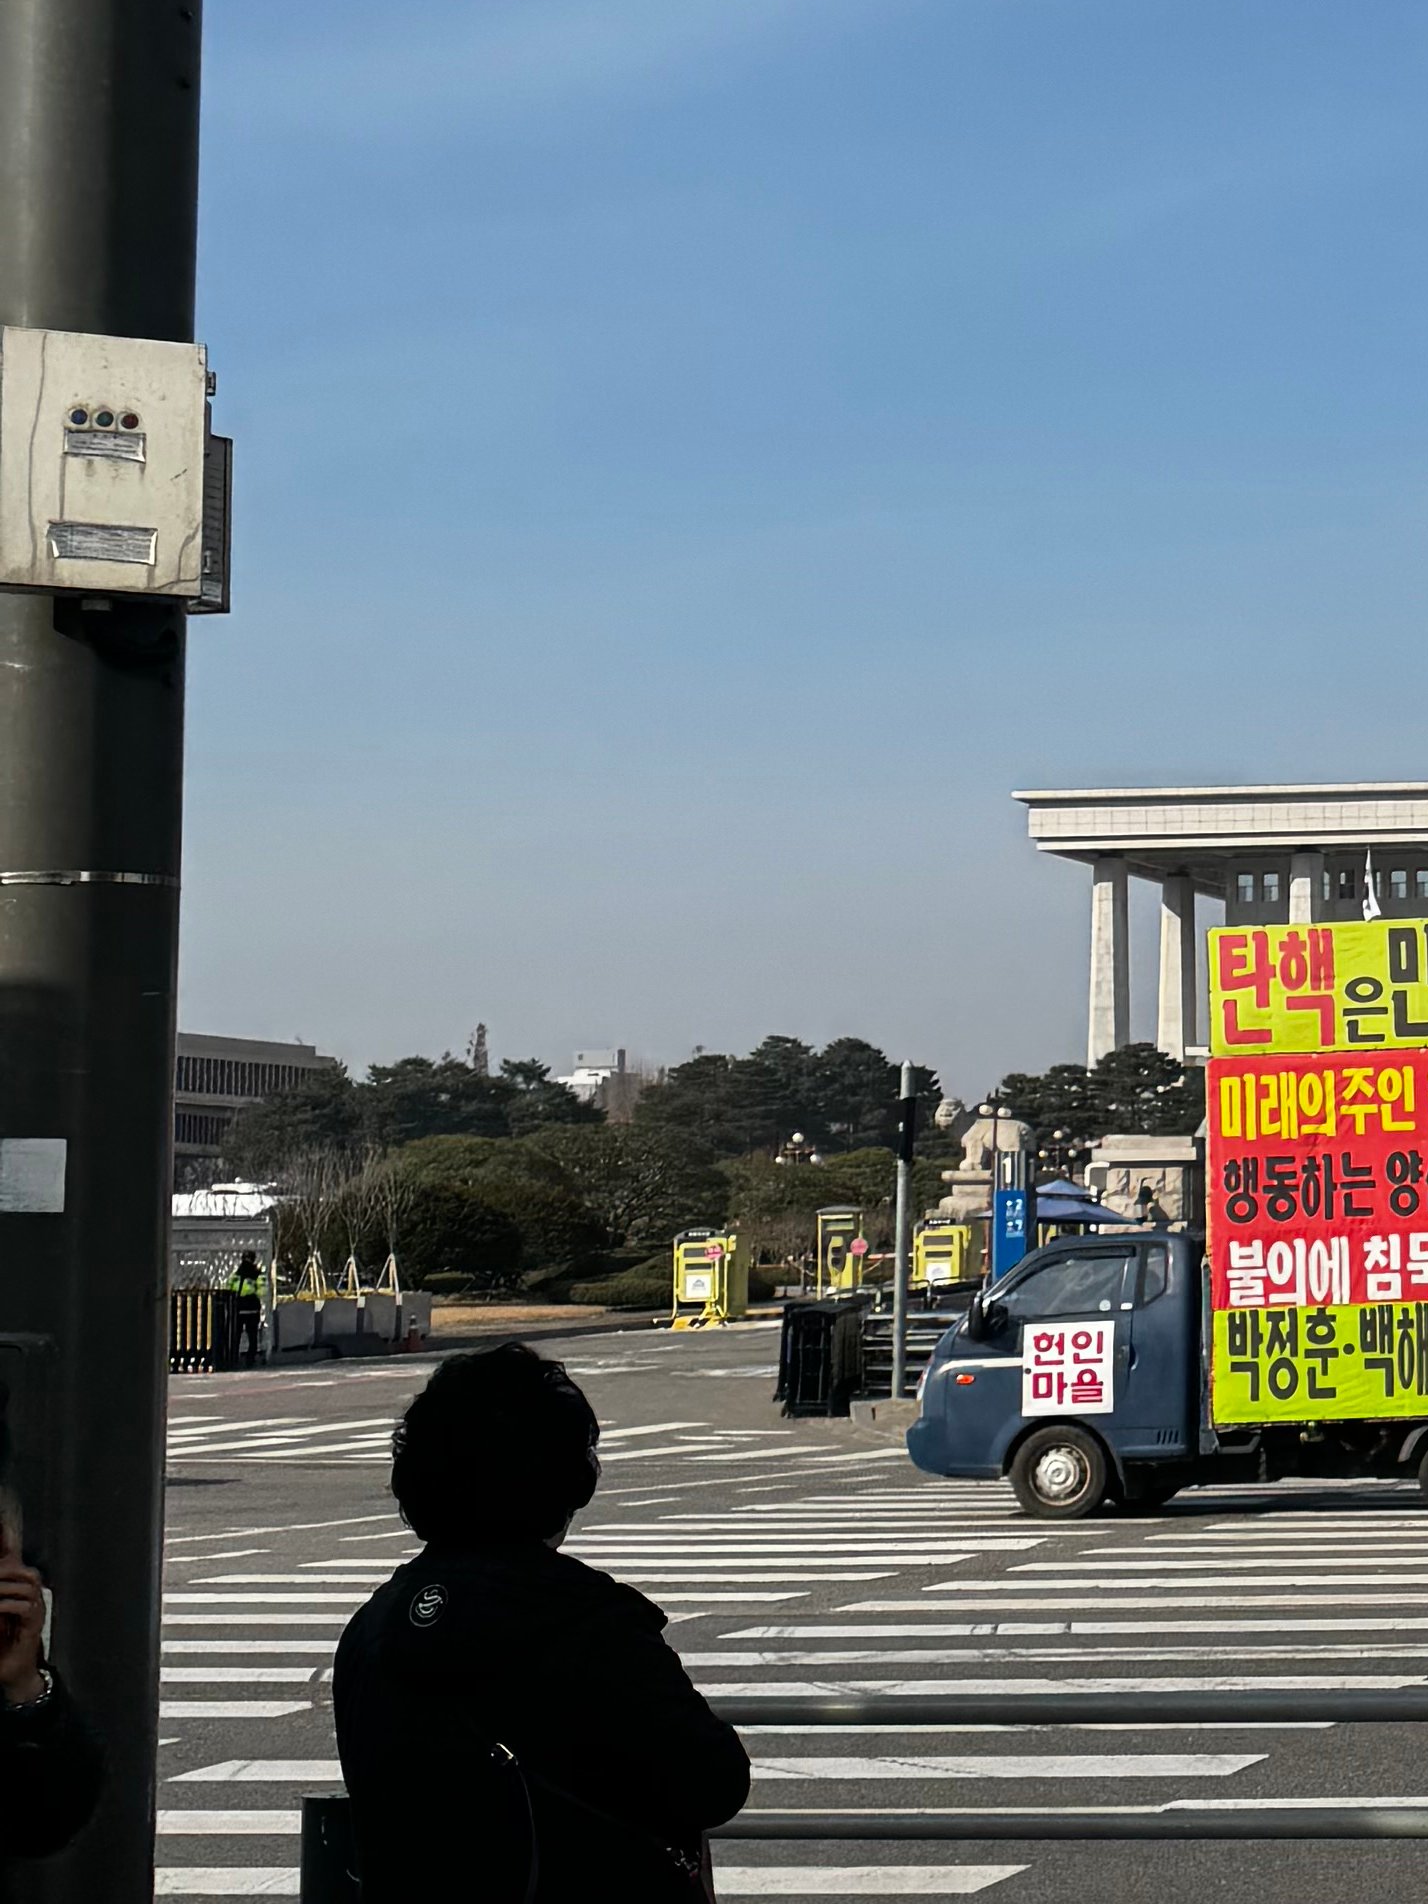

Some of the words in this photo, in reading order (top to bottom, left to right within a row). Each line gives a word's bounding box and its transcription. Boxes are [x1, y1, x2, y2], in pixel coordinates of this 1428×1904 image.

[1224, 1150, 1375, 1223] 행동하는
[1227, 1235, 1350, 1307] 불의에
[1033, 1330, 1103, 1366] 헌인
[1032, 1368, 1103, 1405] 마을
